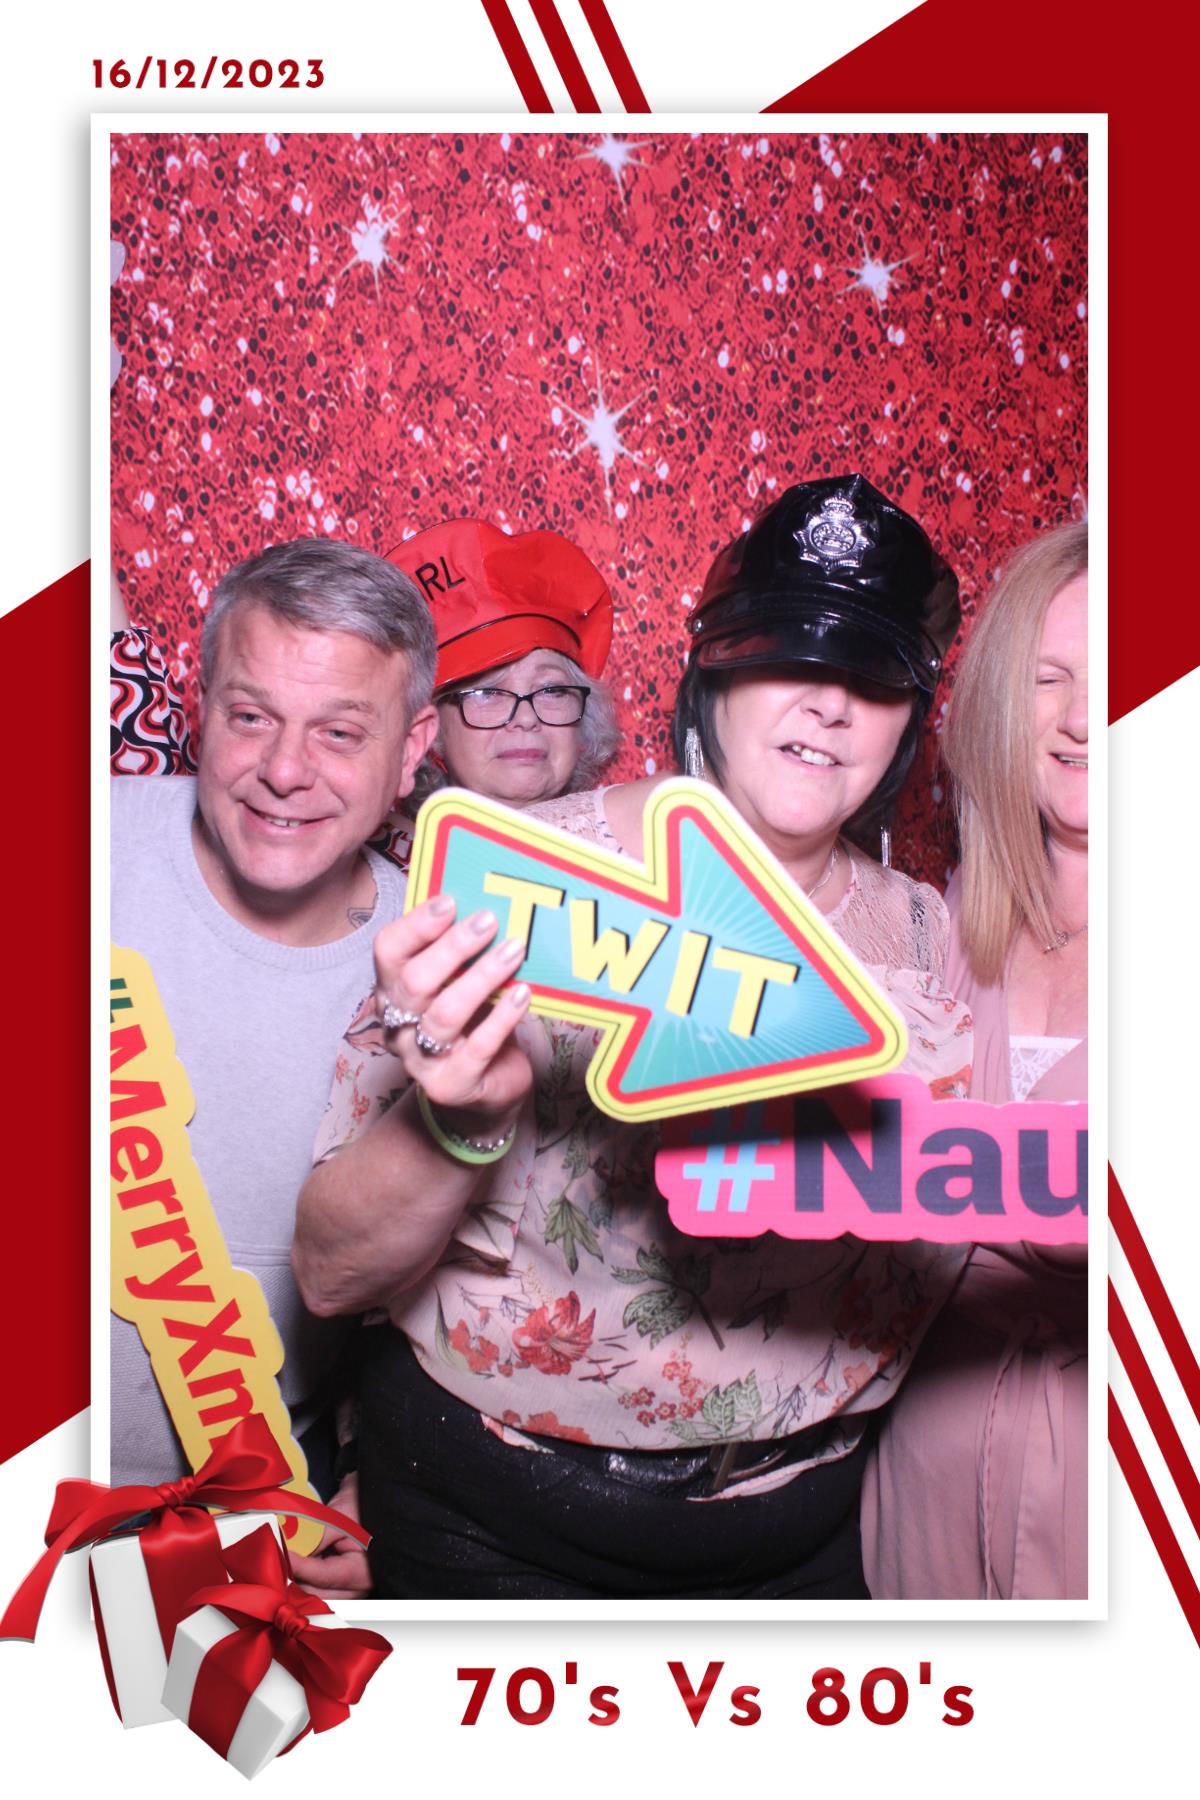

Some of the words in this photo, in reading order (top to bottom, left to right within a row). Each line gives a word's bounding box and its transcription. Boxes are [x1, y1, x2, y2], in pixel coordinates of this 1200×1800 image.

[483, 871, 801, 1040] TWIT
[682, 1097, 1088, 1217] #Nau
[110, 977, 299, 1541] MerryXm
